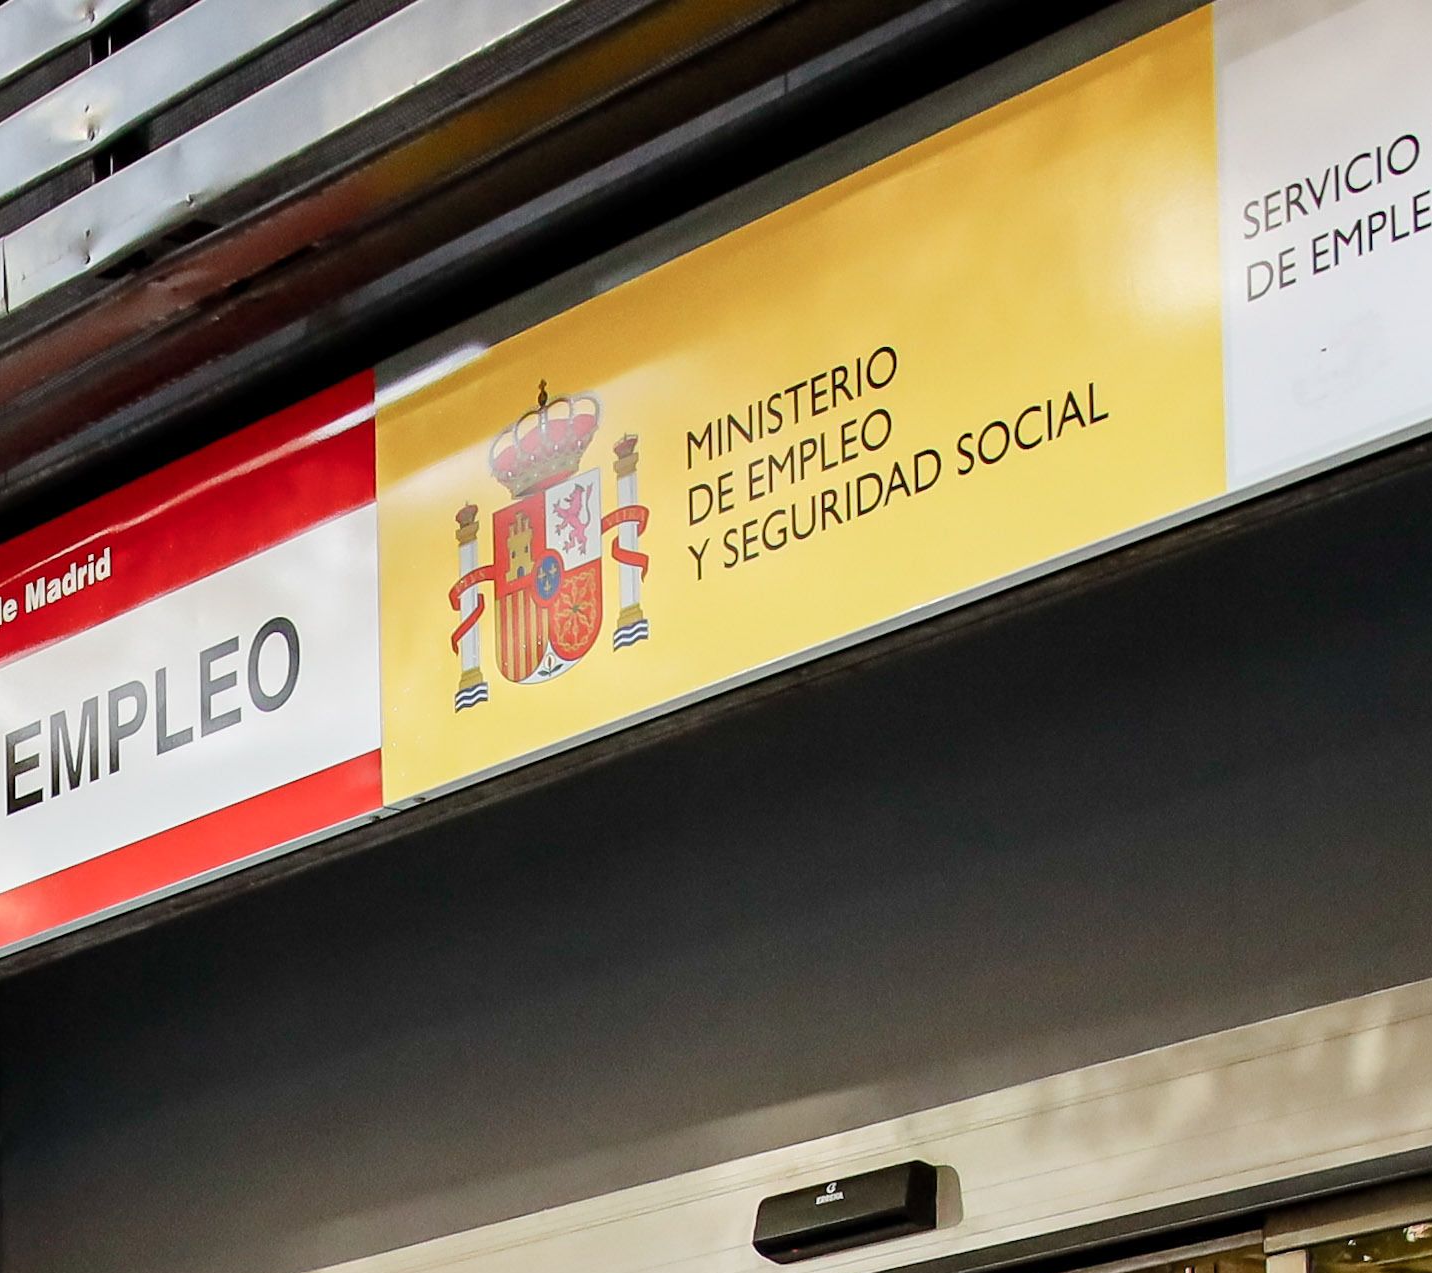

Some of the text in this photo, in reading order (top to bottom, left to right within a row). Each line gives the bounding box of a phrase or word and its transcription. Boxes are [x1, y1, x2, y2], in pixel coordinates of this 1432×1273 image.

[1242, 134, 1420, 240] SERVICIO
[1246, 247, 1297, 302] DE
[684, 345, 899, 469] MINISTERIO
[686, 406, 894, 529] DE EMPLEO
[686, 381, 1110, 582] Y SEGURIDAD SOCIAL
[23, 546, 113, 615] Madrid
[5, 615, 300, 816] EMPLEO
